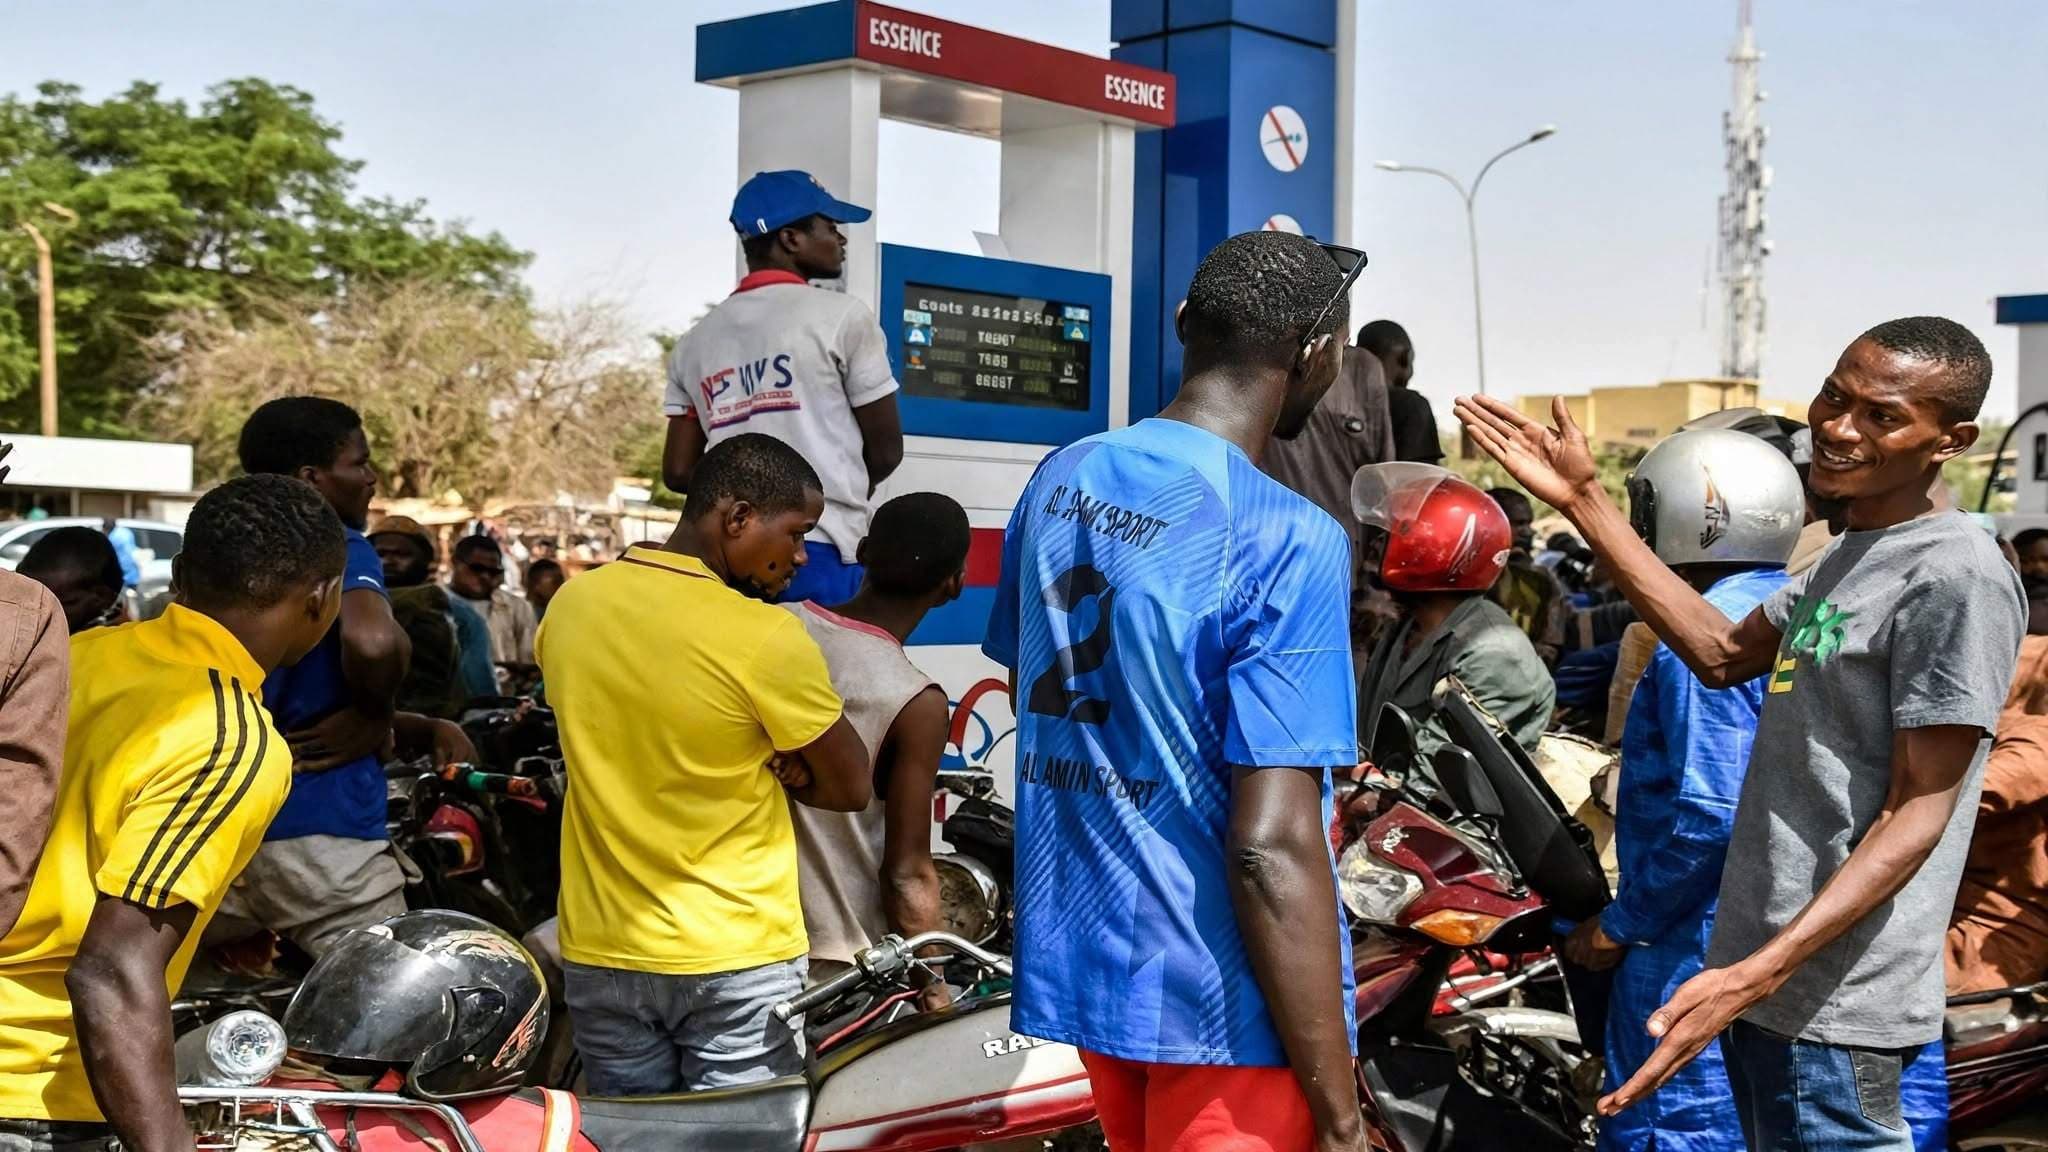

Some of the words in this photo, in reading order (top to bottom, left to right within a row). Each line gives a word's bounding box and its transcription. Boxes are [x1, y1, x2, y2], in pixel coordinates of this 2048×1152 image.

[870, 17, 942, 59] ESSENCE
[1105, 74, 1165, 111] ESSENCE
[1102, 505, 1170, 550] SPORT
[1027, 563, 1116, 725] 2
[1020, 751, 1039, 784] AL
[1042, 755, 1091, 794] AMIN
[1094, 765, 1160, 811] SPORT
